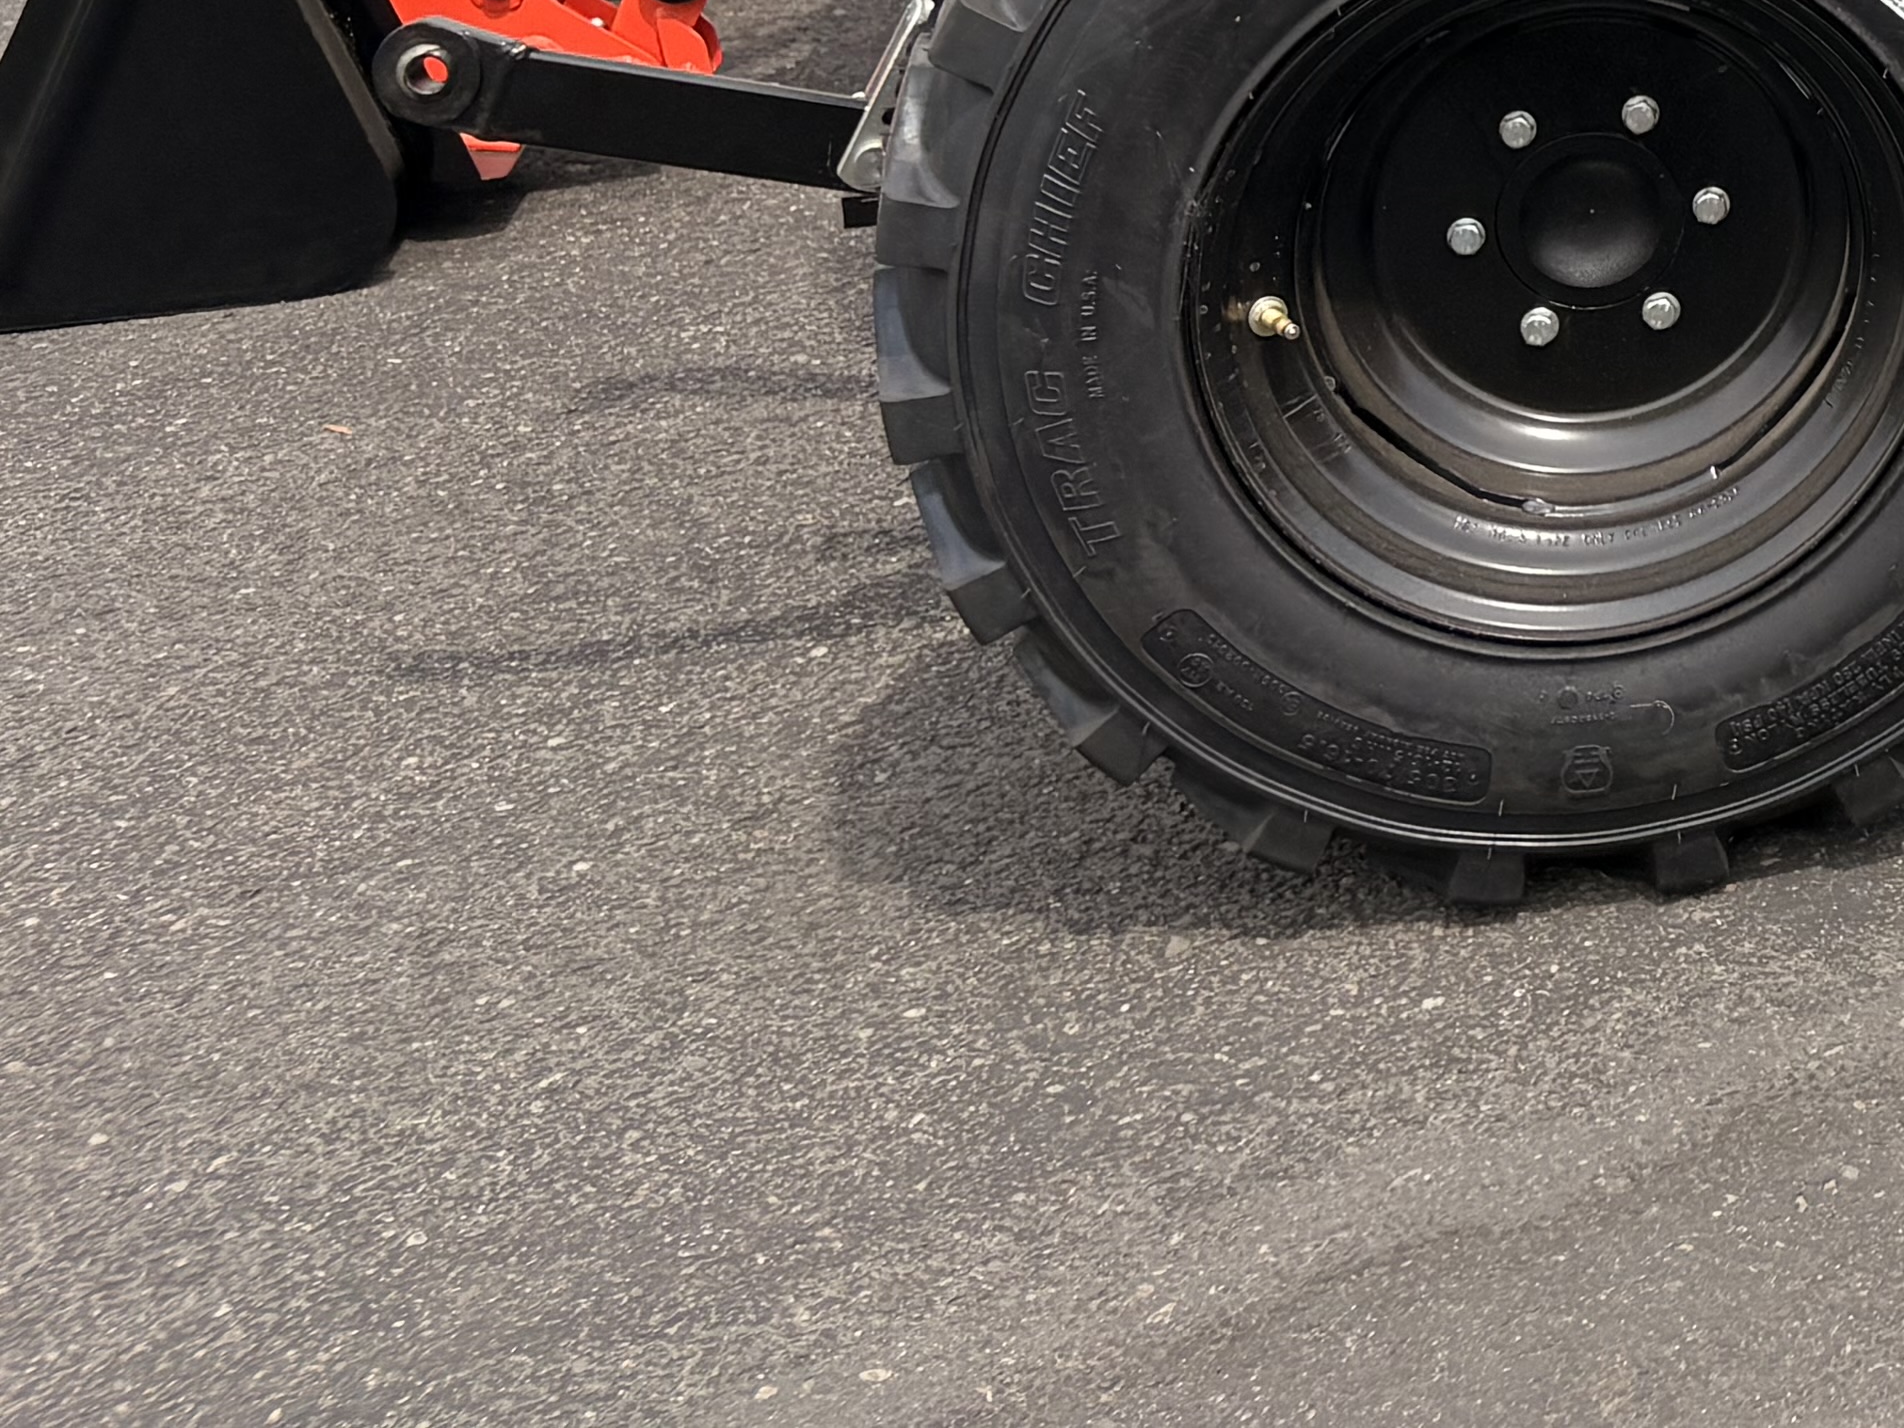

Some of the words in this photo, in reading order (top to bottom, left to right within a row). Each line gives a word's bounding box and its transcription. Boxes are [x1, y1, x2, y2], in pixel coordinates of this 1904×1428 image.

[1023, 88, 1104, 306] CHIEF
[1081, 326, 1098, 342] IN
[1087, 355, 1104, 399] MADE
[1025, 371, 1123, 557] TRAC
